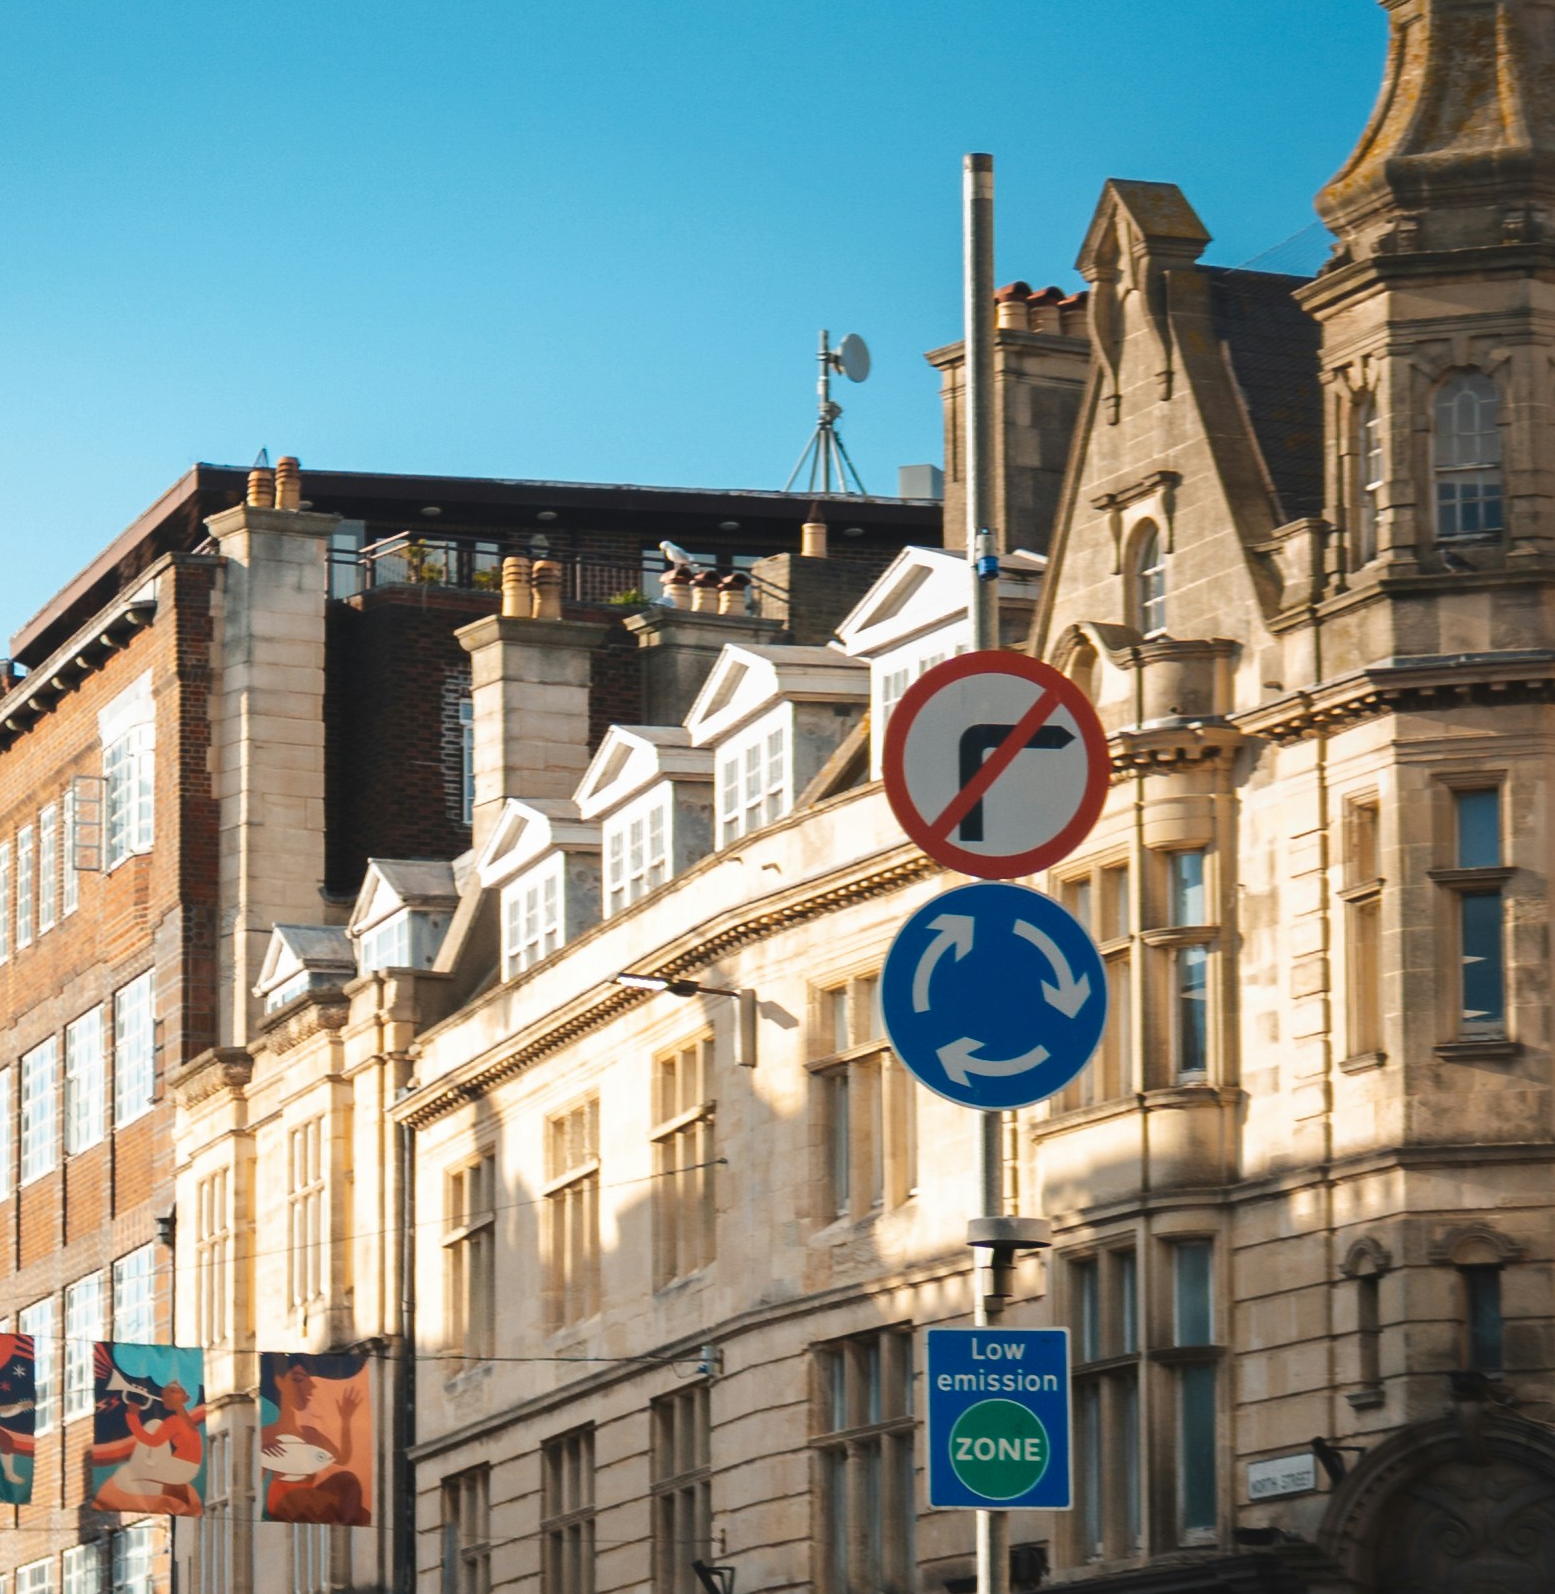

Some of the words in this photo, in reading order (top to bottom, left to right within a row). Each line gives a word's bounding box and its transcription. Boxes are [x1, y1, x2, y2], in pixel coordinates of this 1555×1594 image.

[971, 1337, 1026, 1360] Low
[937, 1369, 1058, 1391] emission
[956, 1437, 1041, 1462] ZONE
